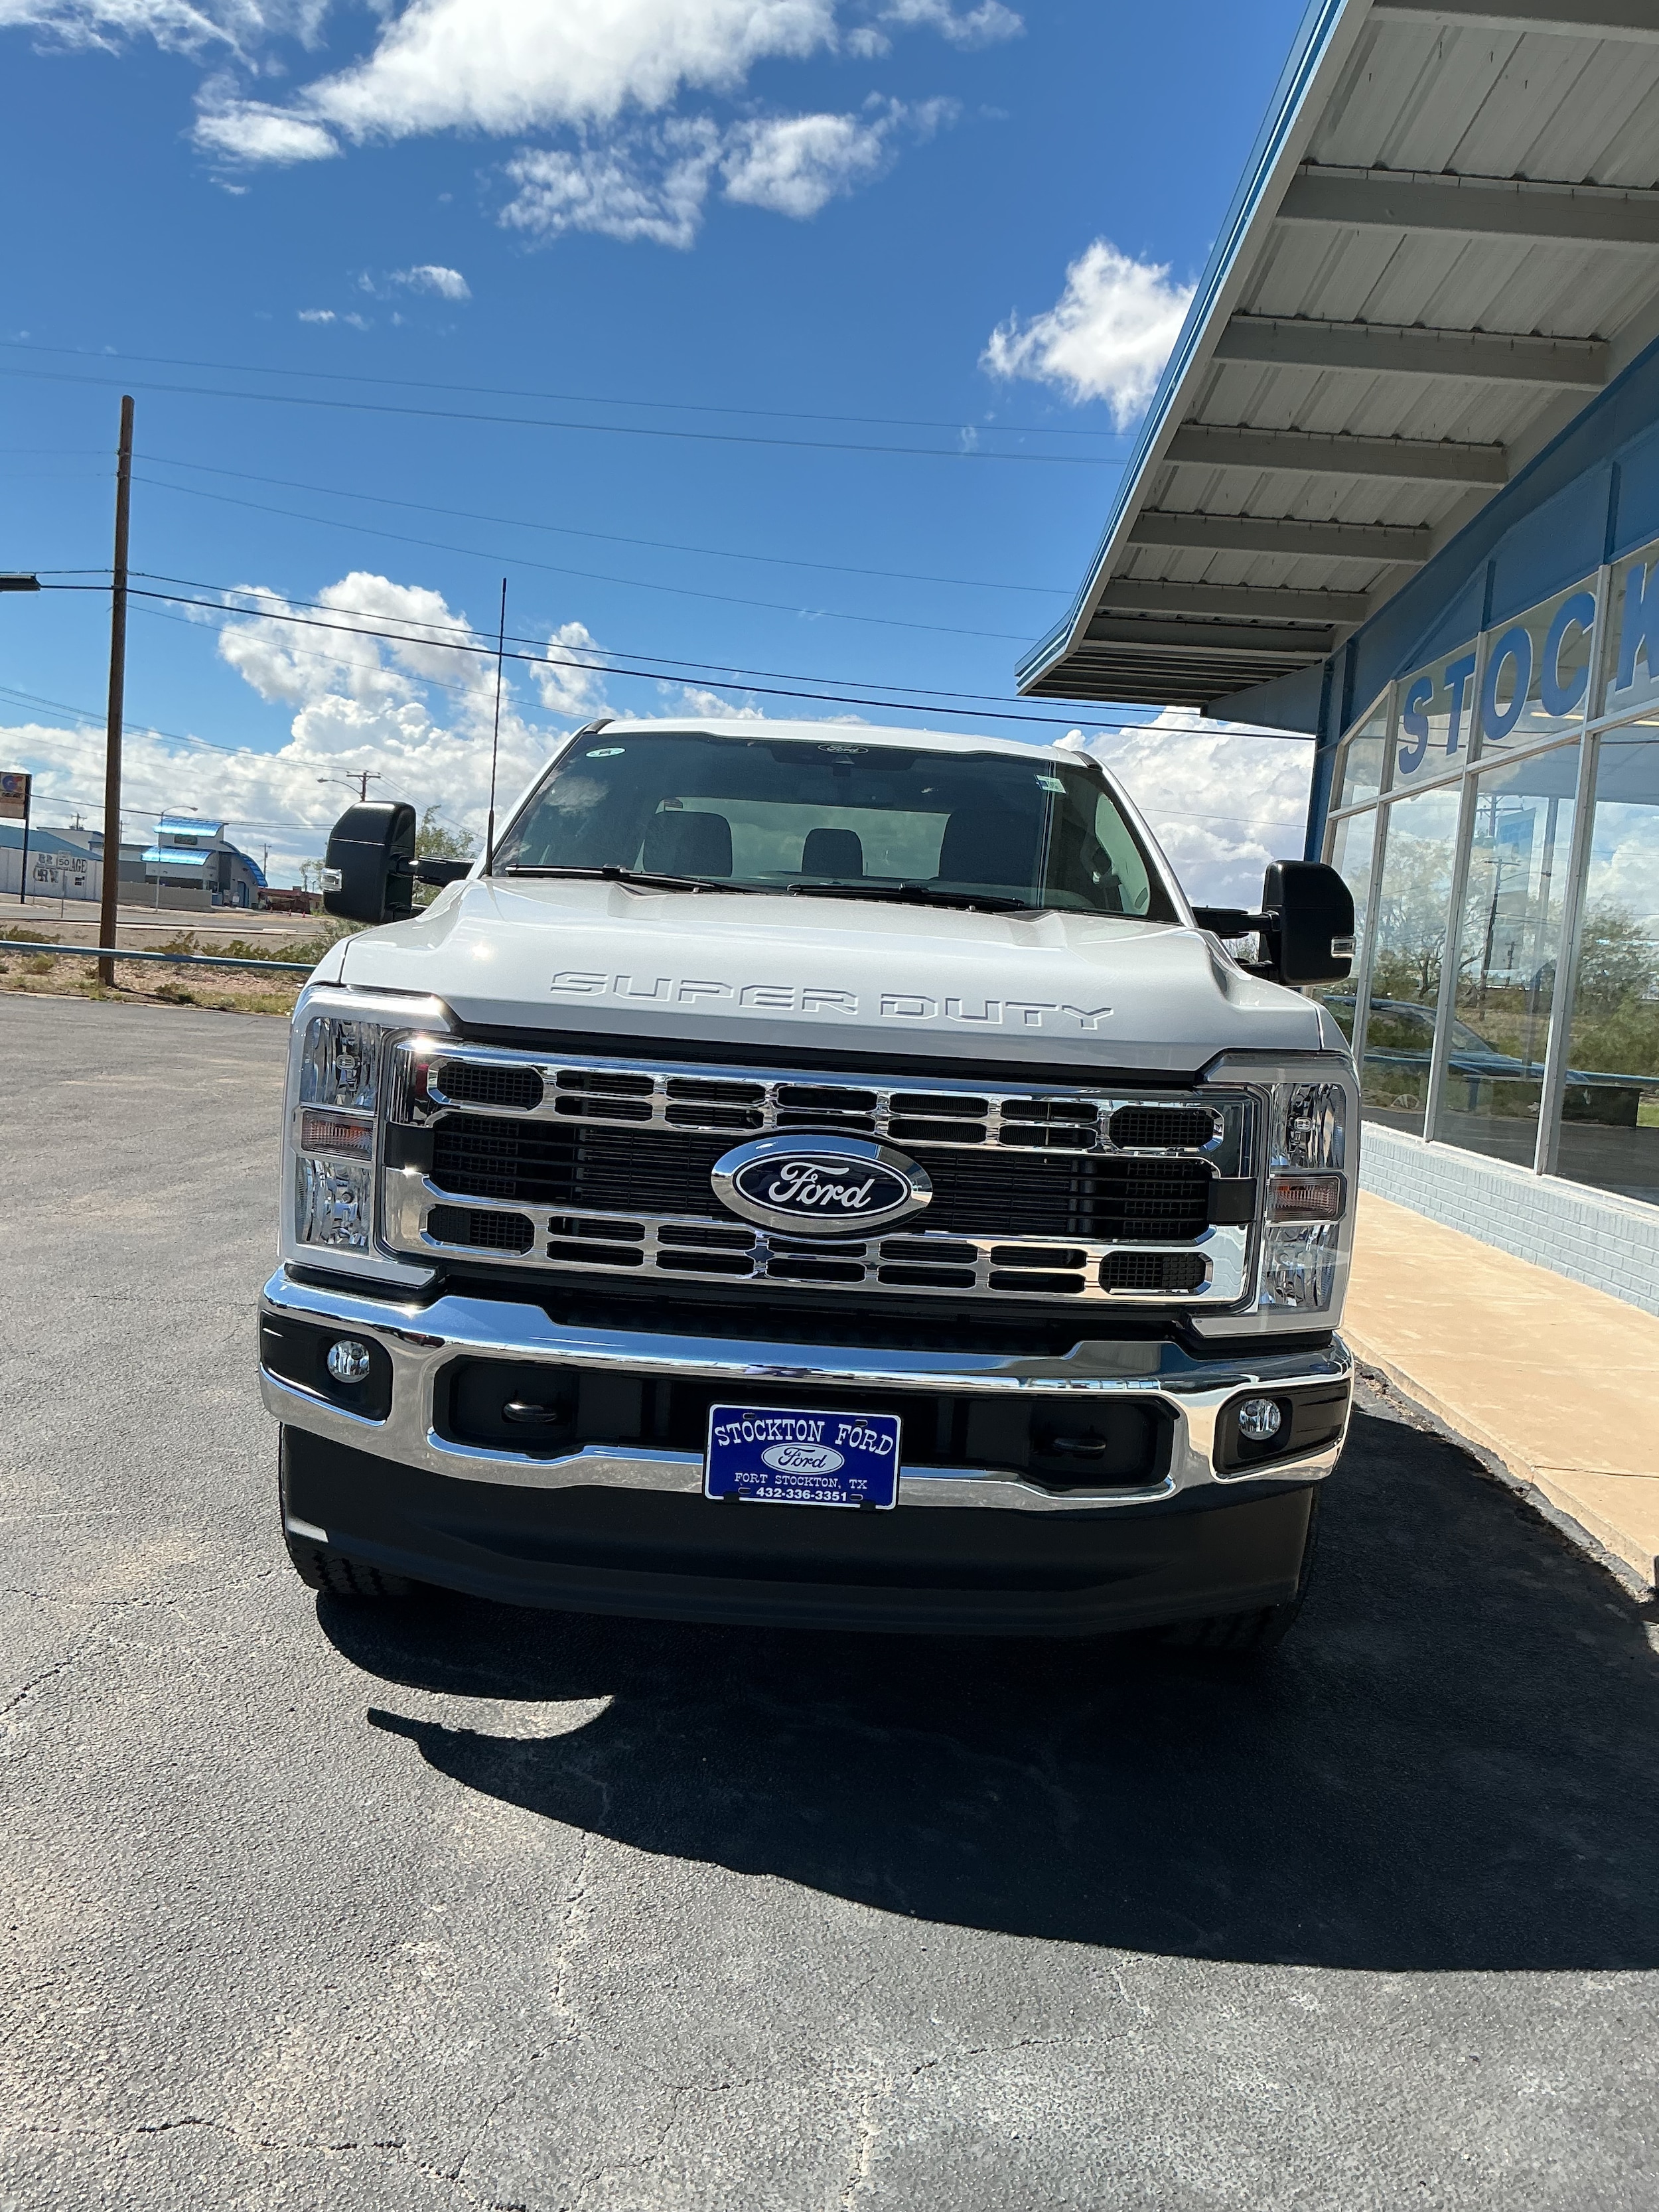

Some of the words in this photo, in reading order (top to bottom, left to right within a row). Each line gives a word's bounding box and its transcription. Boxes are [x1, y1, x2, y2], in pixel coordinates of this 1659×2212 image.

[550, 971, 859, 1015] SUPER
[880, 993, 1114, 1030] DUTY
[768, 1161, 875, 1208] Ford
[714, 1419, 825, 1447] STOCKTON
[835, 1424, 894, 1455] FORD
[778, 1447, 828, 1468] Ford
[735, 1472, 768, 1484] FORT
[775, 1475, 841, 1489] STOCKTON,
[849, 1479, 867, 1489] TX
[756, 1487, 847, 1502] 432-336-3351
